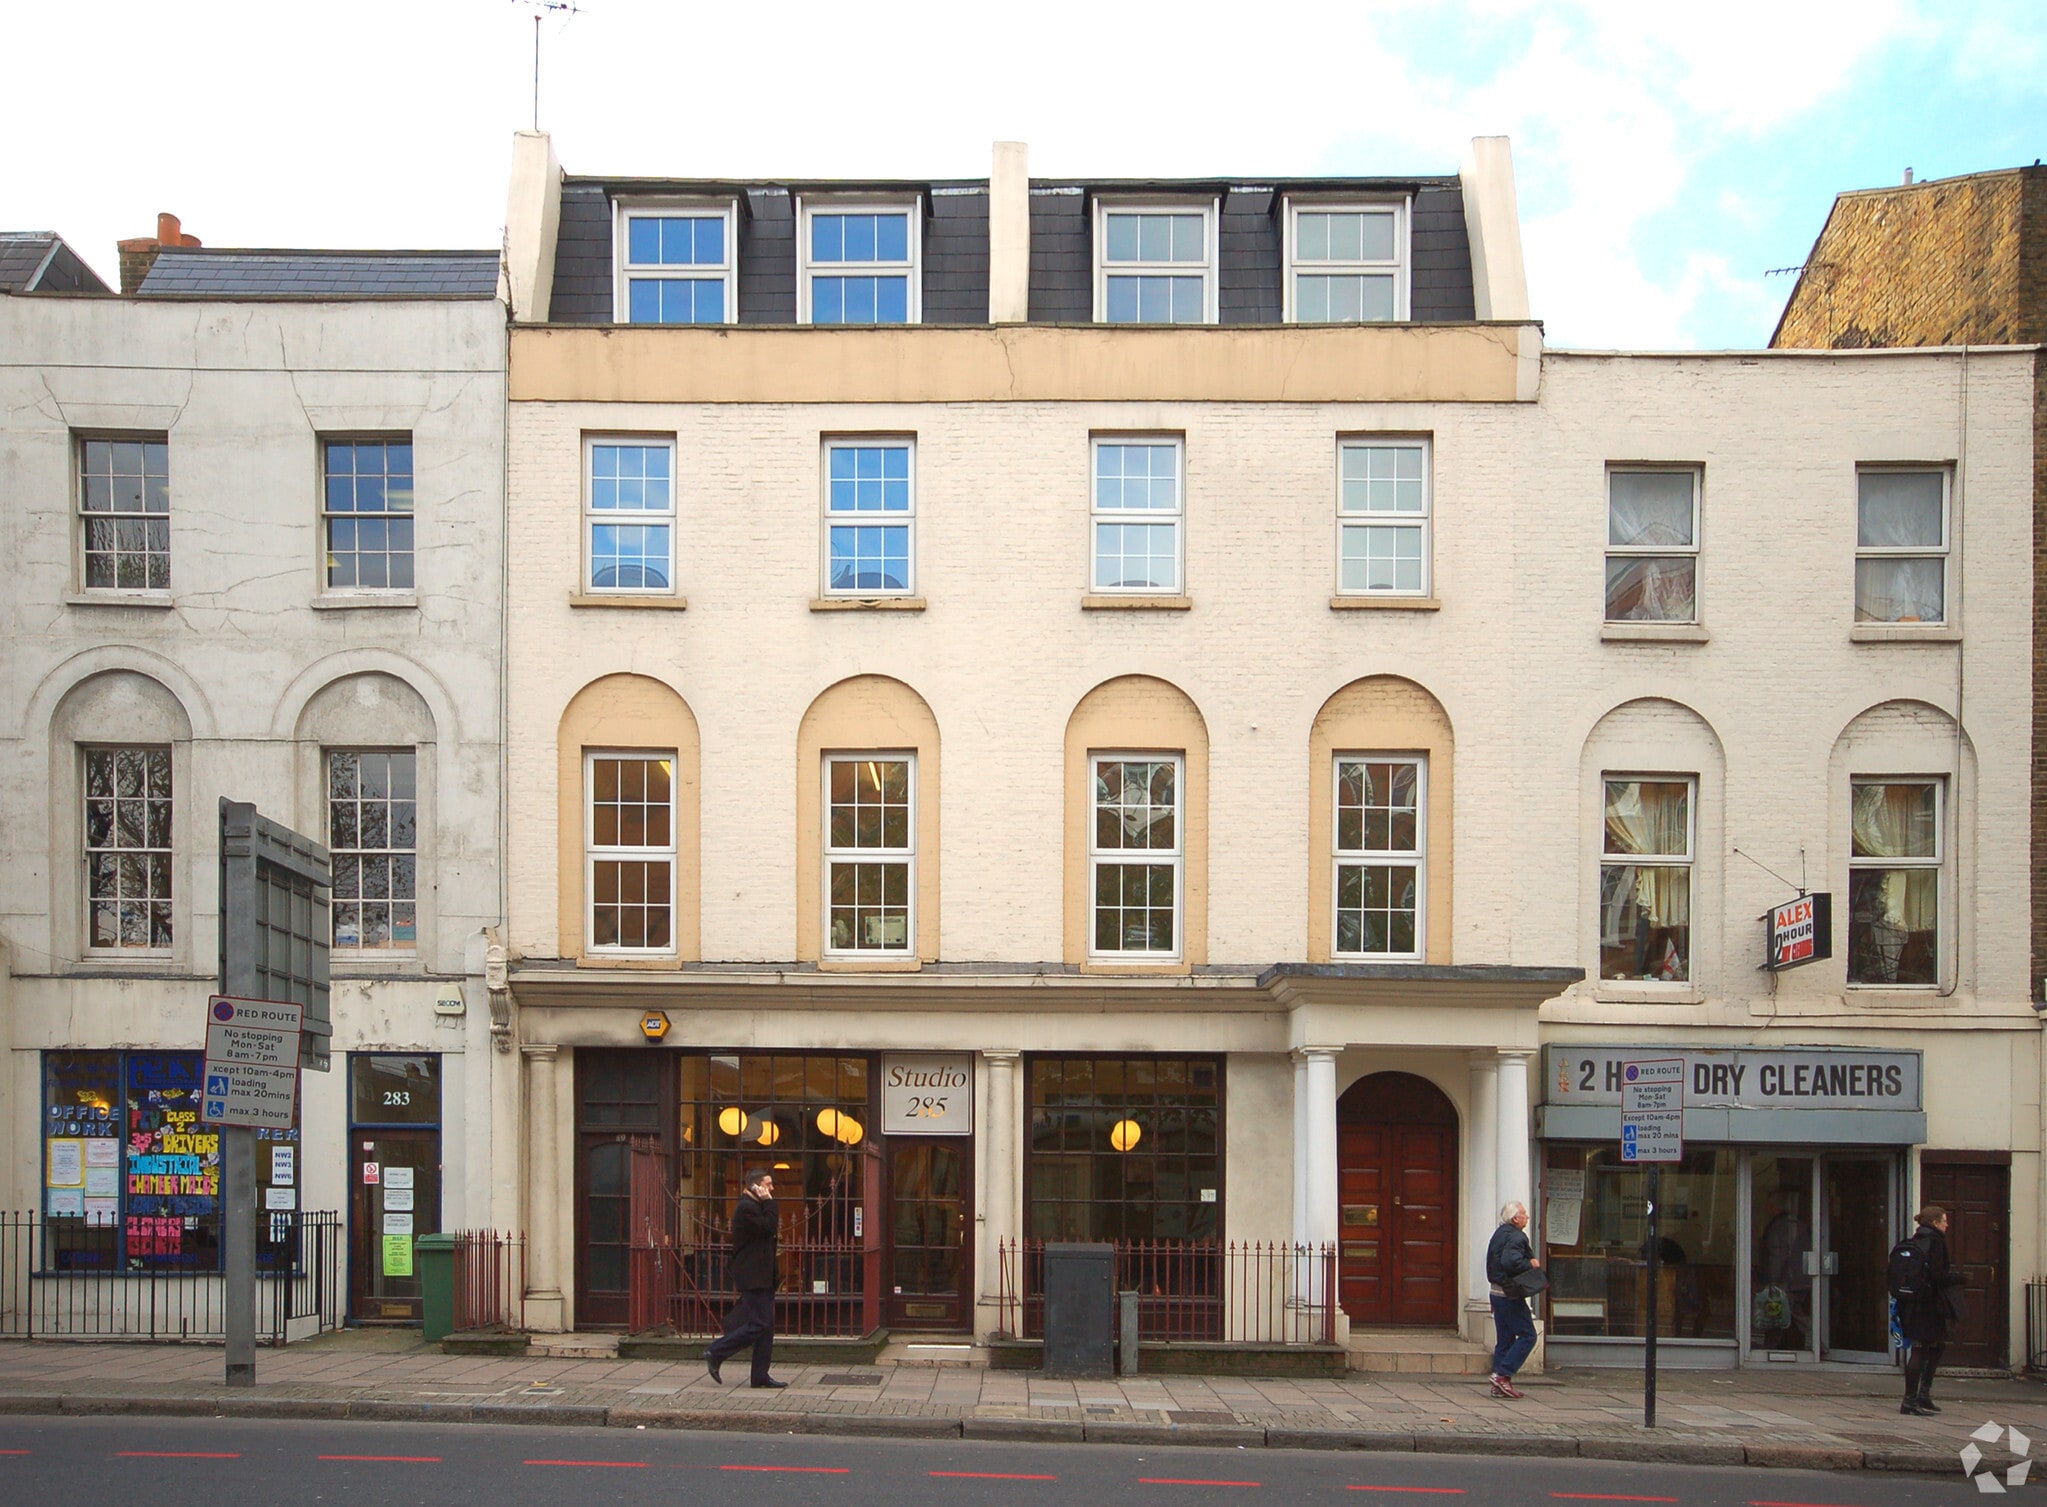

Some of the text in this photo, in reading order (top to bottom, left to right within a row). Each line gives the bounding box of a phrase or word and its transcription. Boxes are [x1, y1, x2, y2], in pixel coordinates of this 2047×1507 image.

[1776, 901, 1812, 929] ALEX
[1775, 933, 1783, 966] 2
[1783, 923, 1812, 942] HOUR
[236, 1008, 297, 1022] RED ROUTE
[647, 1019, 661, 1028] ADT
[224, 1029, 283, 1043] No stopping
[231, 1040, 275, 1051] Mon-Sat
[243, 1067, 295, 1079] 10am-4pm
[888, 1065, 966, 1087] Studio
[1579, 1060, 1595, 1091] 2
[1694, 1064, 1746, 1096] DRY
[1760, 1064, 1902, 1097] CLEANERS
[231, 1077, 267, 1089] loading
[1644, 1086, 1671, 1094] stopping
[231, 1089, 251, 1097] max
[383, 1091, 411, 1106] 283
[48, 1104, 119, 1121] OFFICE
[229, 1107, 289, 1119] max 3 hours
[905, 1096, 948, 1118] 285
[167, 1111, 196, 1122] CLASS
[1623, 1113, 1680, 1122] Except 10am-4pm
[49, 1121, 112, 1137] WORK
[176, 1122, 185, 1132] 2
[163, 1134, 219, 1153] DRIVERS
[1652, 1146, 1657, 1154] 3
[1658, 1146, 1677, 1154] hours
[129, 1154, 202, 1175] INDUSTRIAL
[128, 1174, 179, 1195] CHAMBER
[180, 1175, 219, 1195] MAIDS
